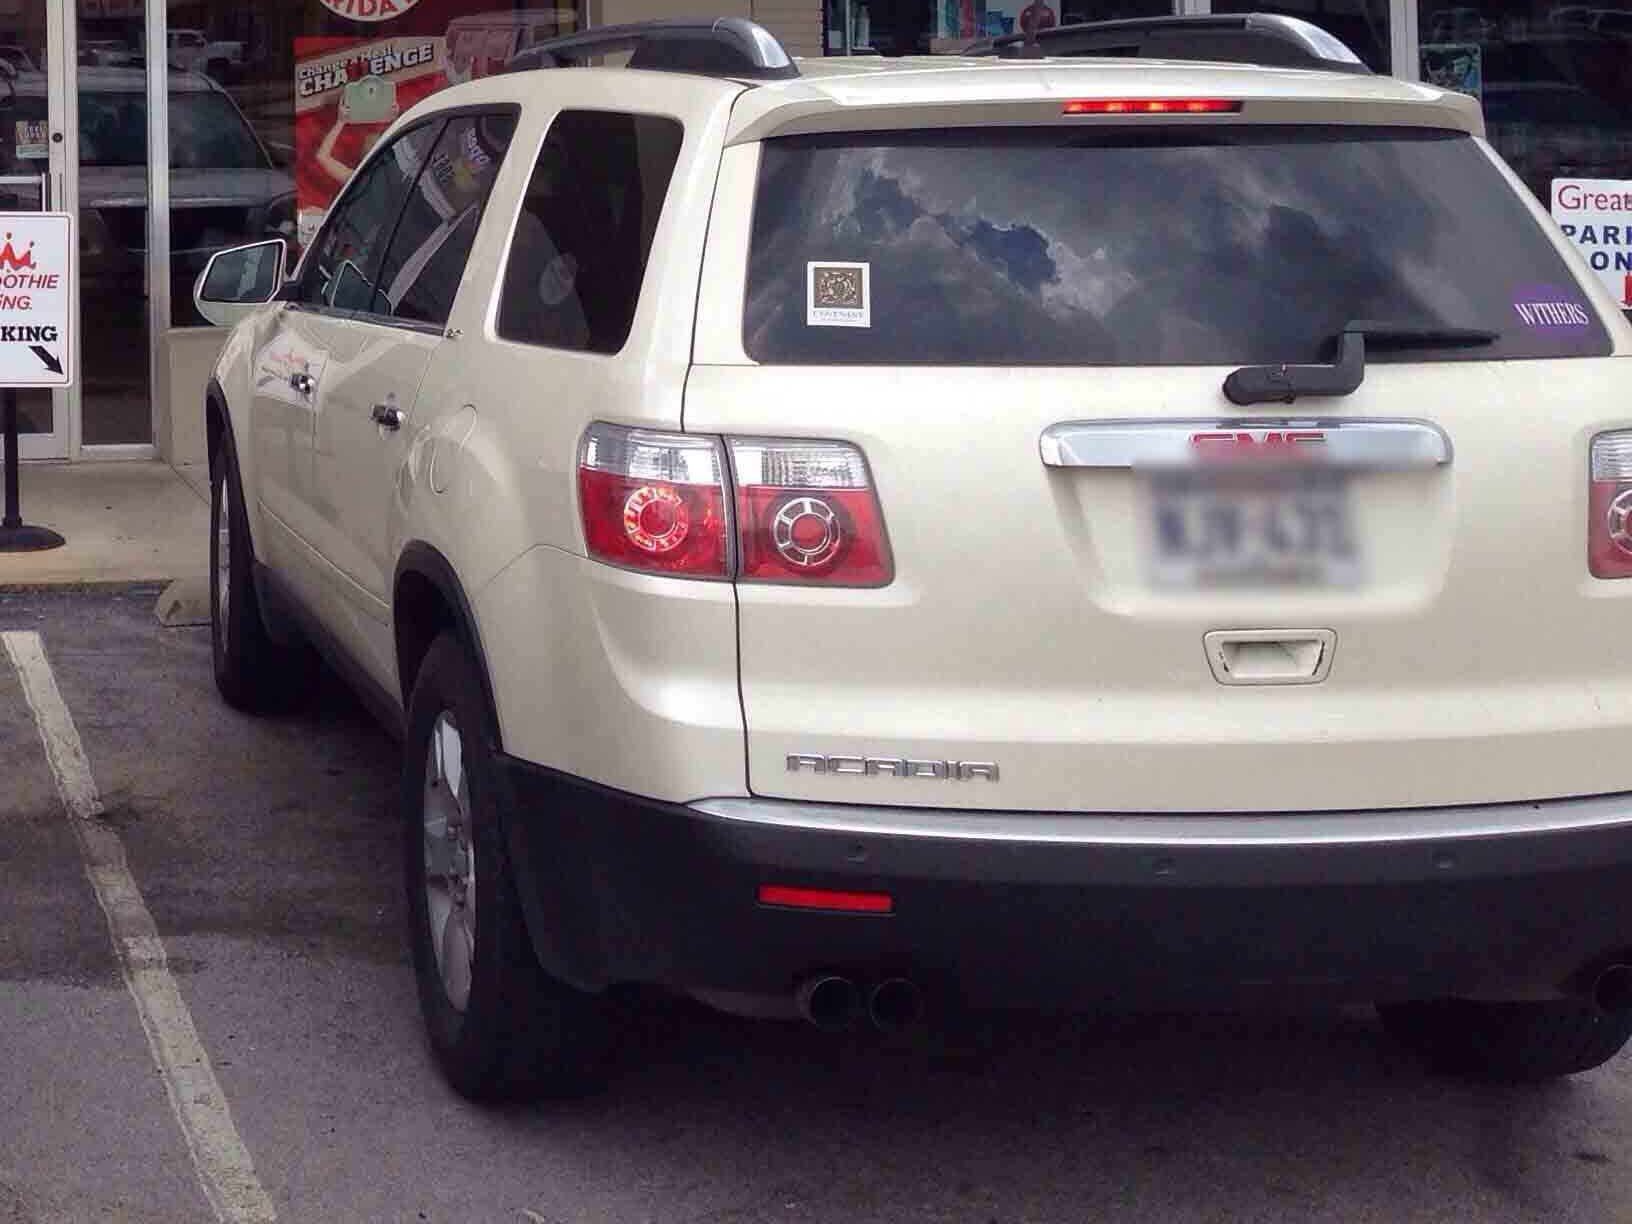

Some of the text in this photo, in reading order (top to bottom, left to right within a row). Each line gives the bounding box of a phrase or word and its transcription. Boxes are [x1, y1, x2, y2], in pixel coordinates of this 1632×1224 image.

[299, 43, 435, 97] CHAENGE
[1558, 184, 1632, 212] Great
[1514, 303, 1589, 326] WITHERS
